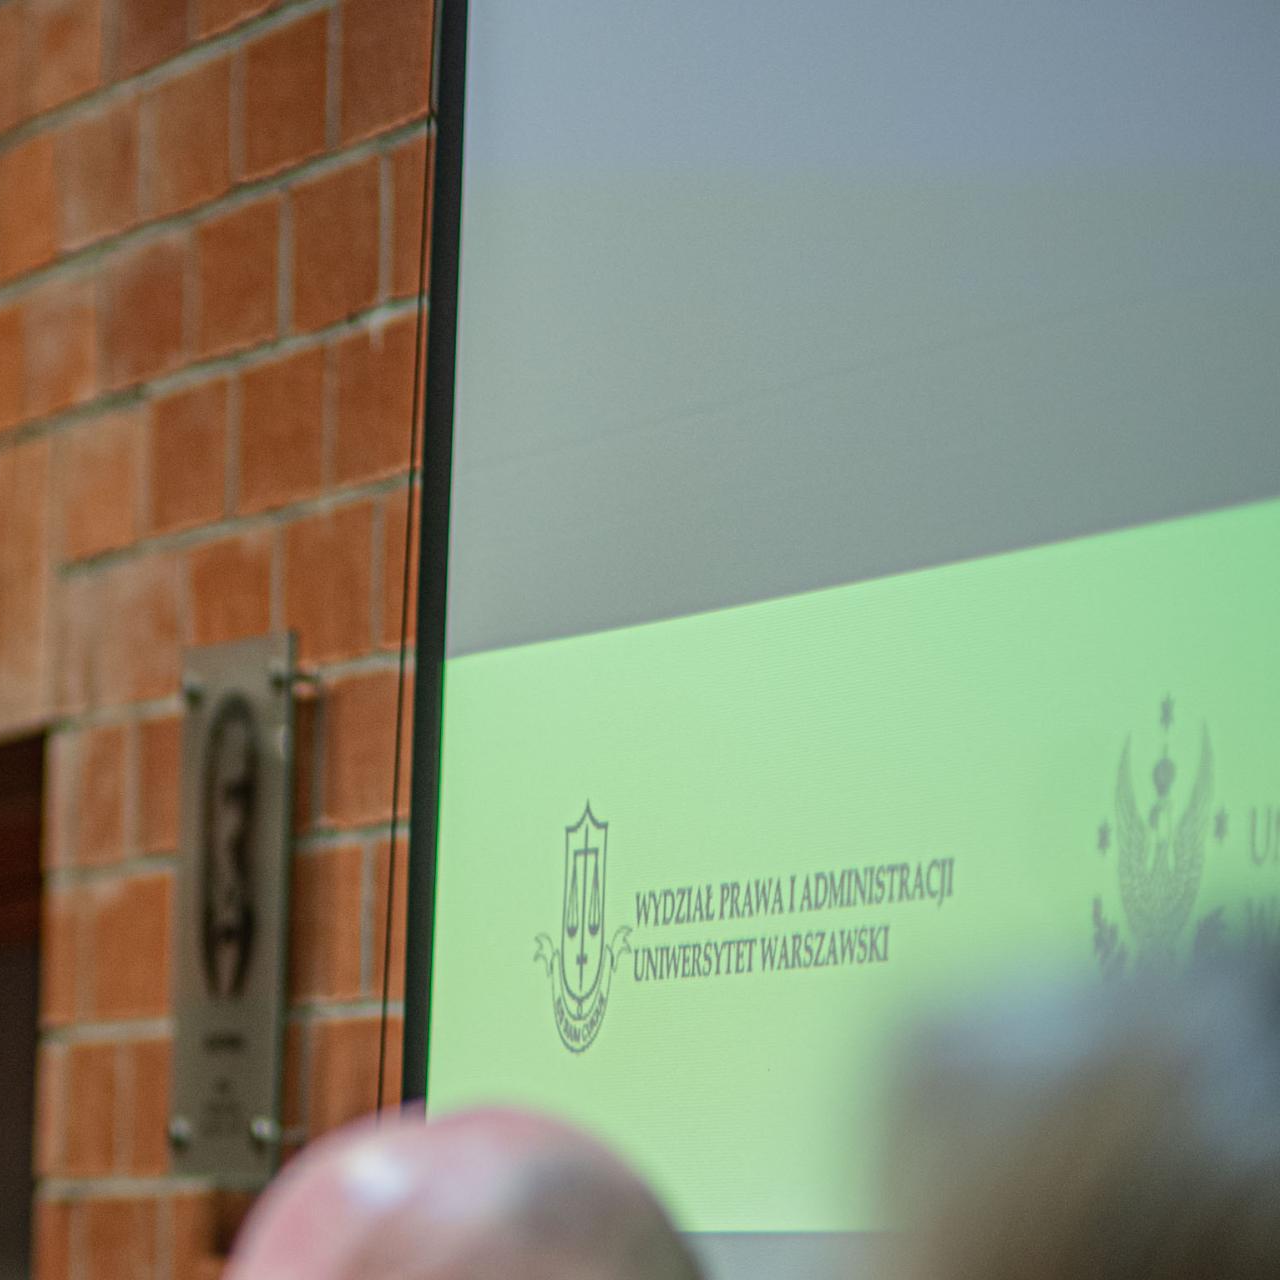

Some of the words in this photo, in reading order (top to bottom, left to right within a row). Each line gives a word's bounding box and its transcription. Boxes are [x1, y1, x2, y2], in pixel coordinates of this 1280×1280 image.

[634, 882, 716, 929] WYDZIAŁ
[718, 875, 785, 921] PRAWA
[788, 873, 798, 914] I
[799, 856, 956, 912] ADMINISTRACJI
[632, 936, 758, 983] UNIWERSYTET
[759, 924, 891, 974] WARSZAWSKI
